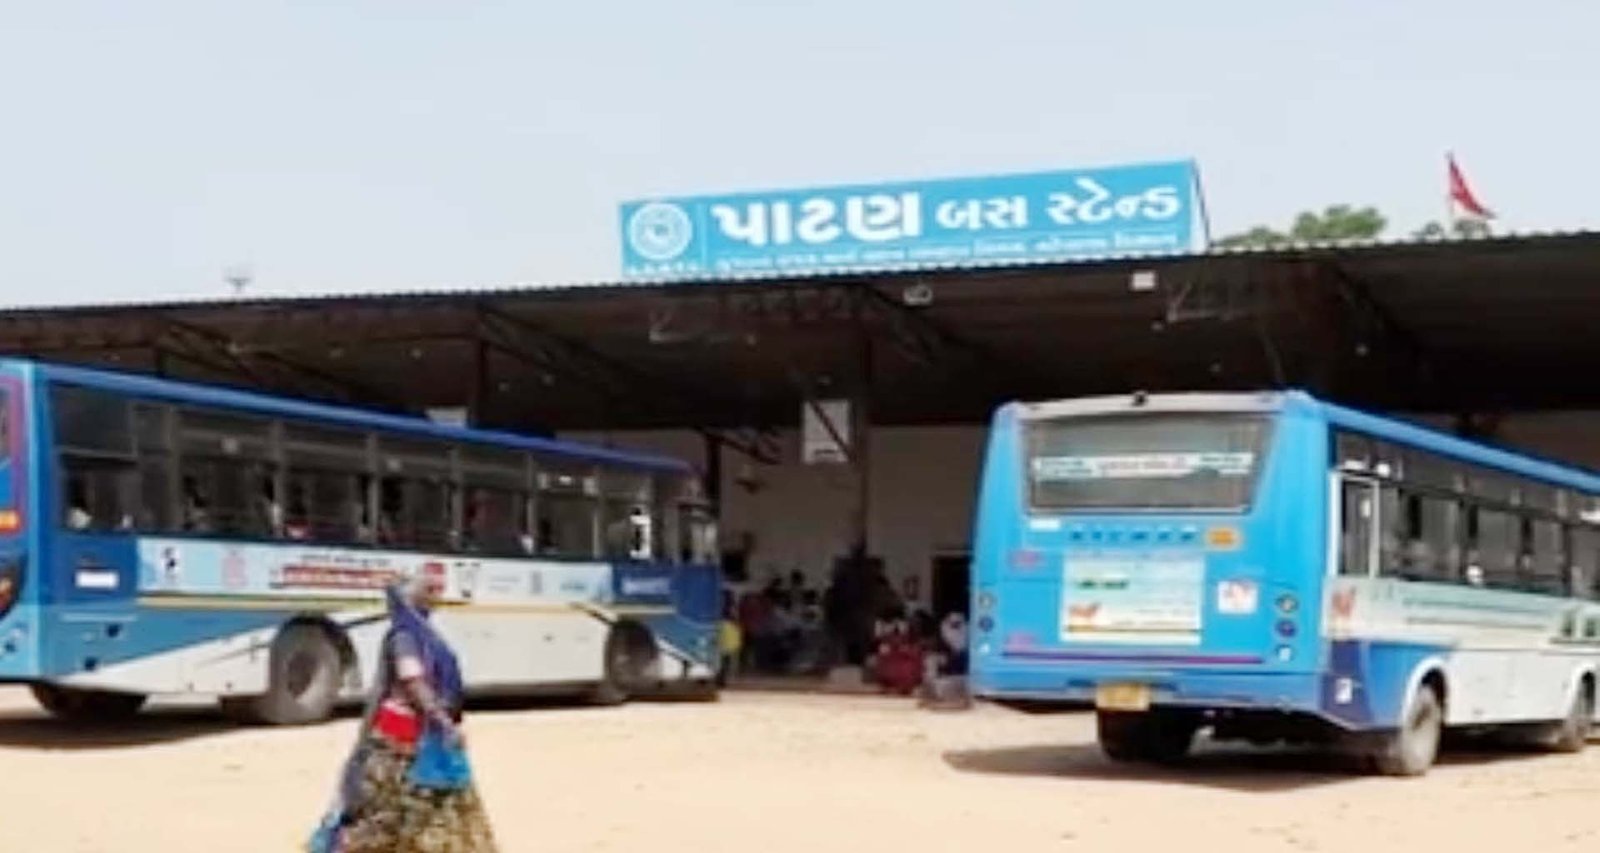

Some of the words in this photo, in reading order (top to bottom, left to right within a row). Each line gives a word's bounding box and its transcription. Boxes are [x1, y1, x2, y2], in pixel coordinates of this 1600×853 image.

[711, 192, 920, 247] પાટણ
[936, 196, 1028, 231] બસ
[1047, 176, 1180, 225] સ્ટેન્ડ
